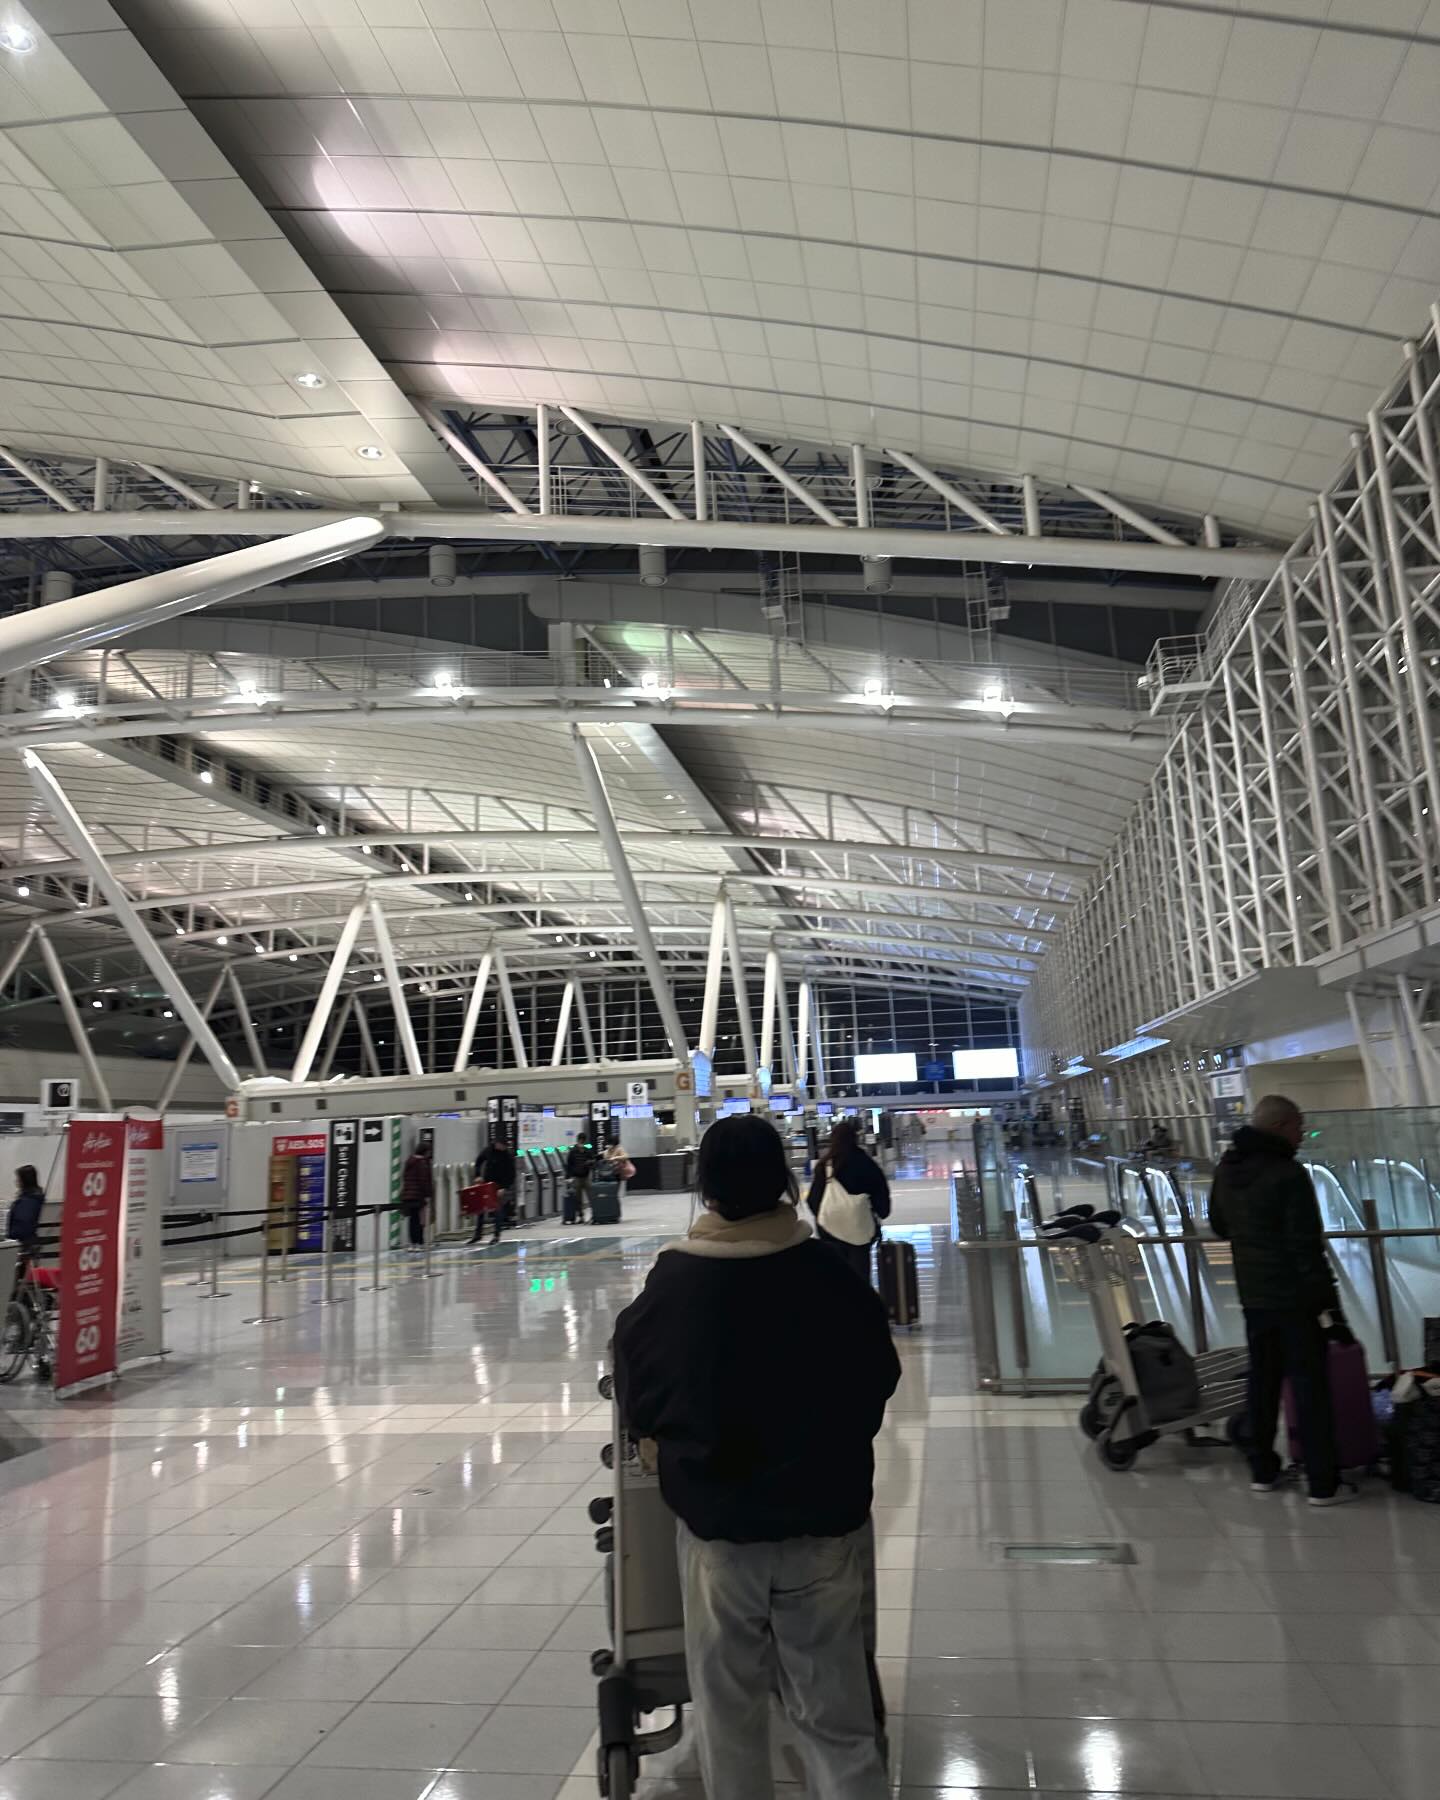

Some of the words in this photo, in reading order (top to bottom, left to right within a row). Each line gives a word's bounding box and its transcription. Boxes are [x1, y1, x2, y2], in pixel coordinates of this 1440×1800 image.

[676, 1072, 690, 1090] G
[338, 1146, 349, 1165] Self
[82, 1171, 107, 1197] 60
[79, 1245, 103, 1271] 60
[75, 1325, 100, 1354] 60
